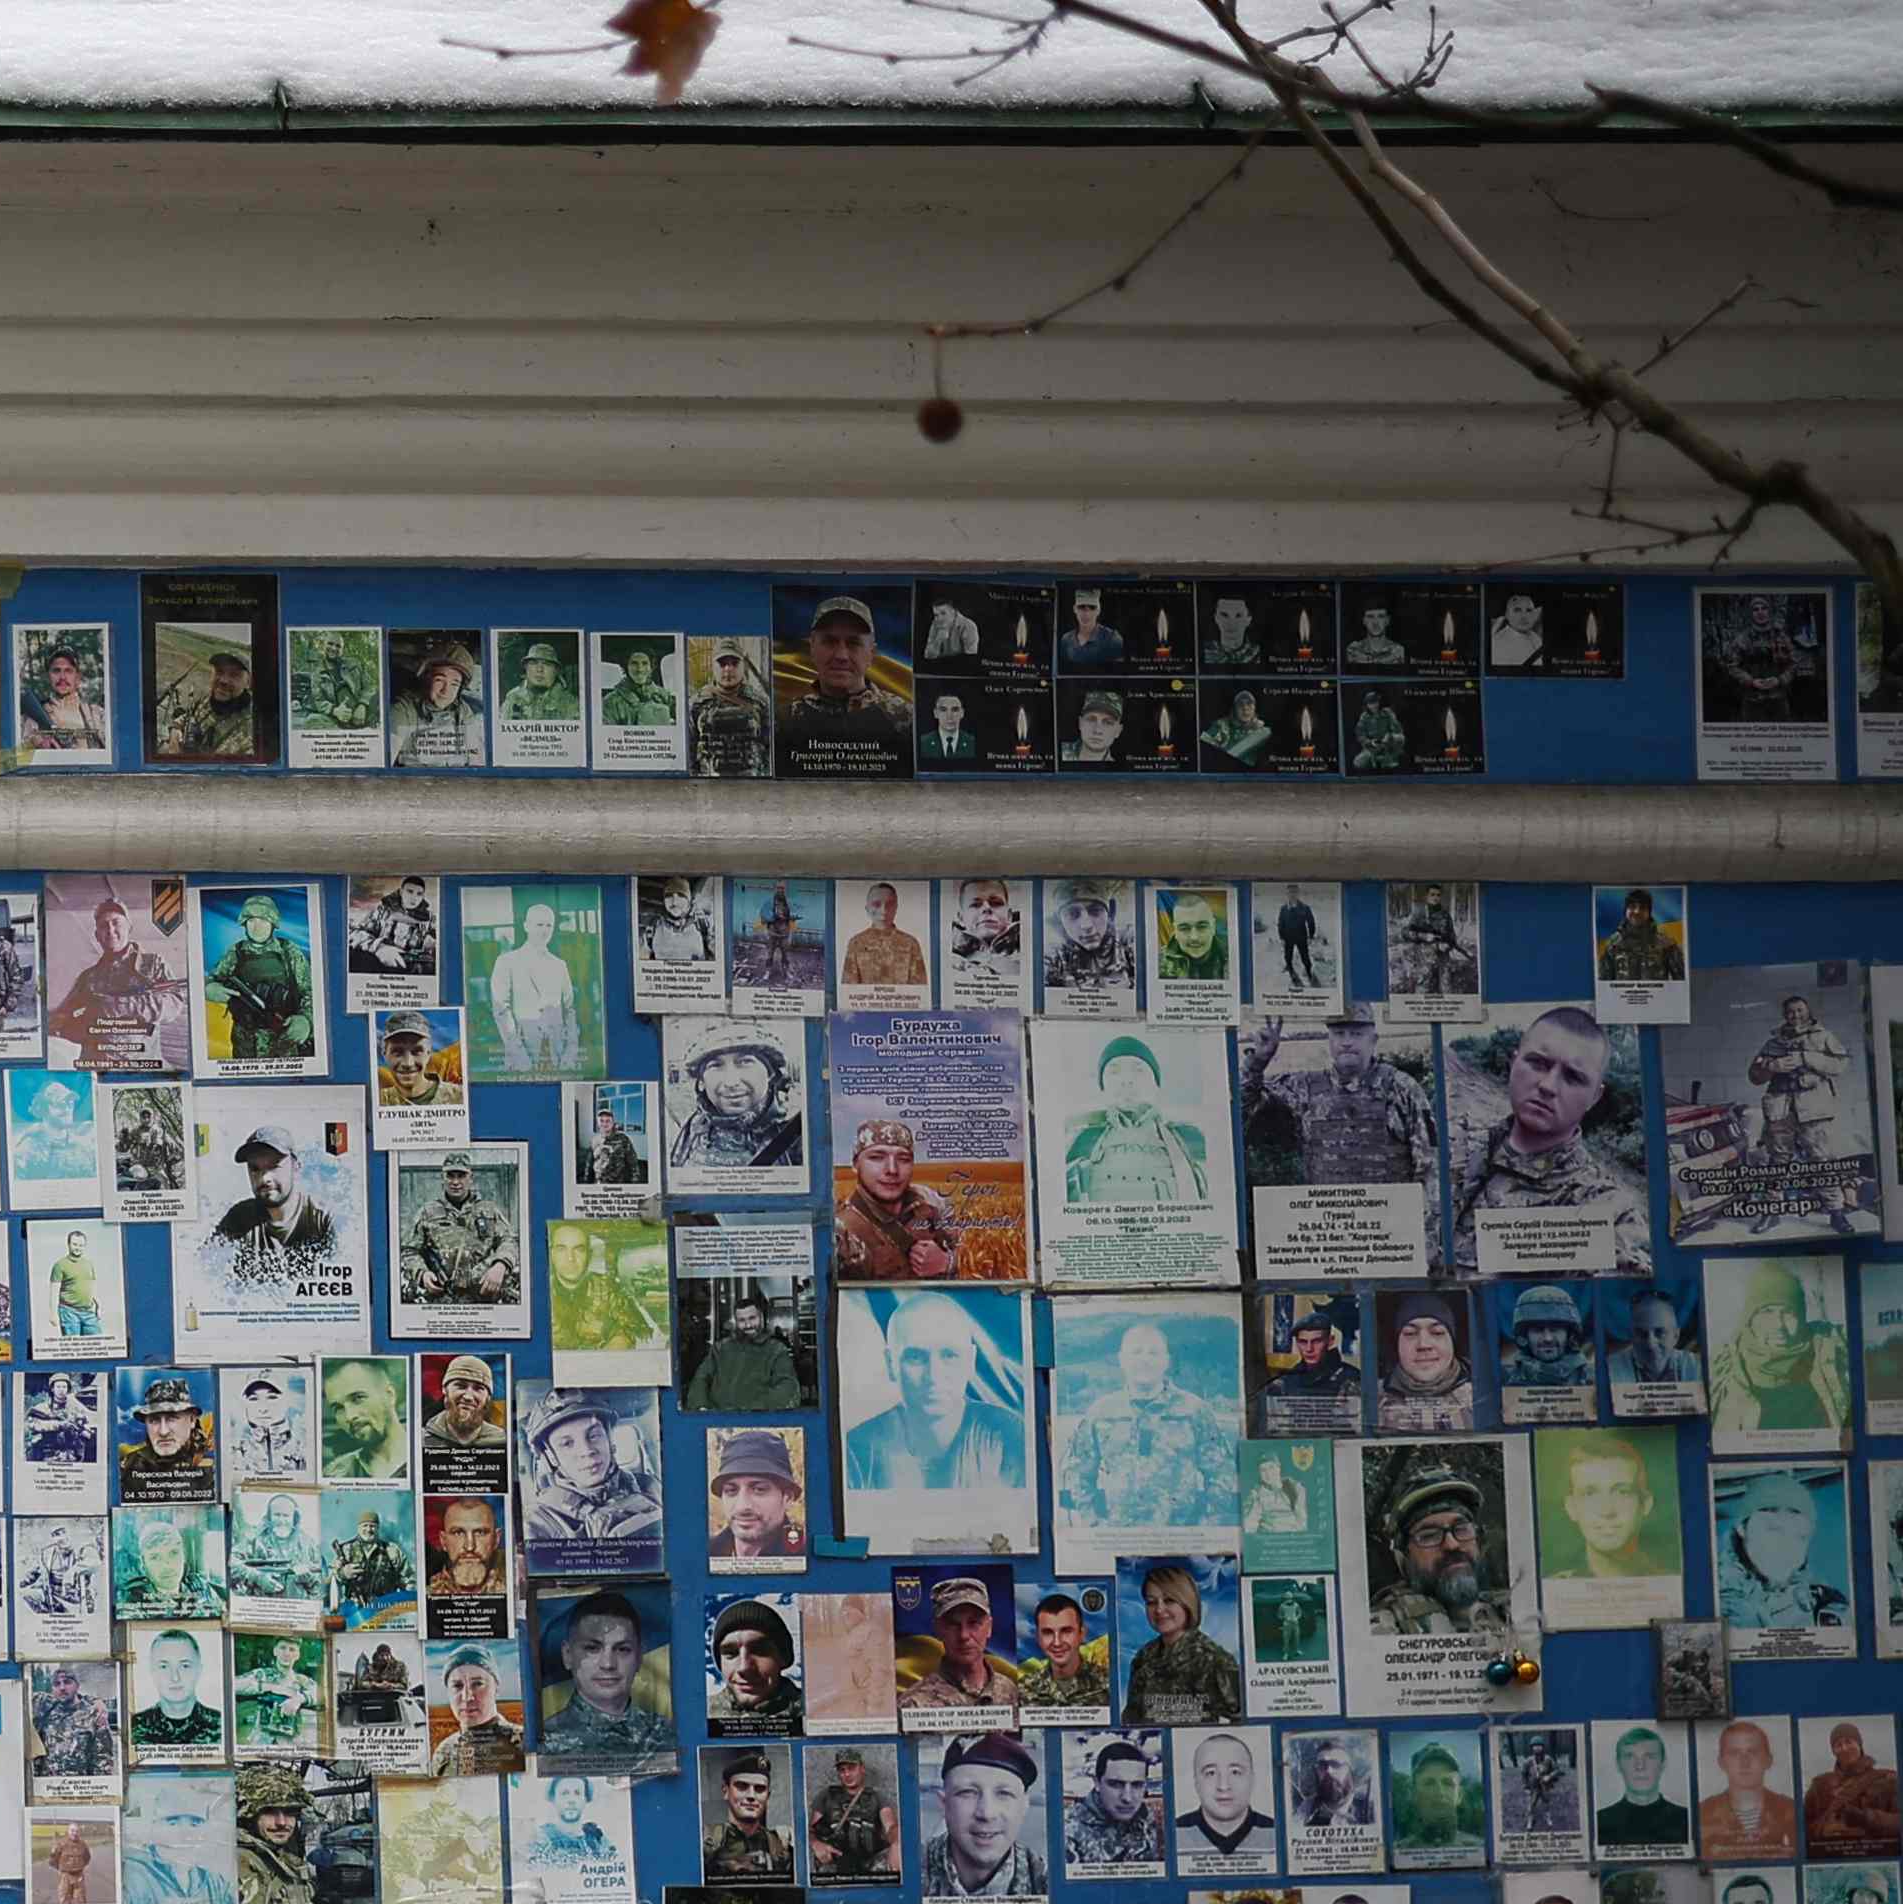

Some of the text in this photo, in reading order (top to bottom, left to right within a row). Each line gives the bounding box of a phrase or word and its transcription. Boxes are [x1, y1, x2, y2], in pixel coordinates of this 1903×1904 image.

[893, 1020, 961, 1032] Бурдужа
[853, 1034, 1001, 1047] Ігор Валентинович
[1679, 1160, 1860, 1182] Сорокін Роман Олегович
[1723, 1201, 1821, 1216] «Кочегар»
[319, 1264, 352, 1278] Ігор
[295, 1283, 353, 1296] АГЄЄВ
[581, 1862, 625, 1875] Андрій
[584, 1877, 625, 1888] ОГЕРА
